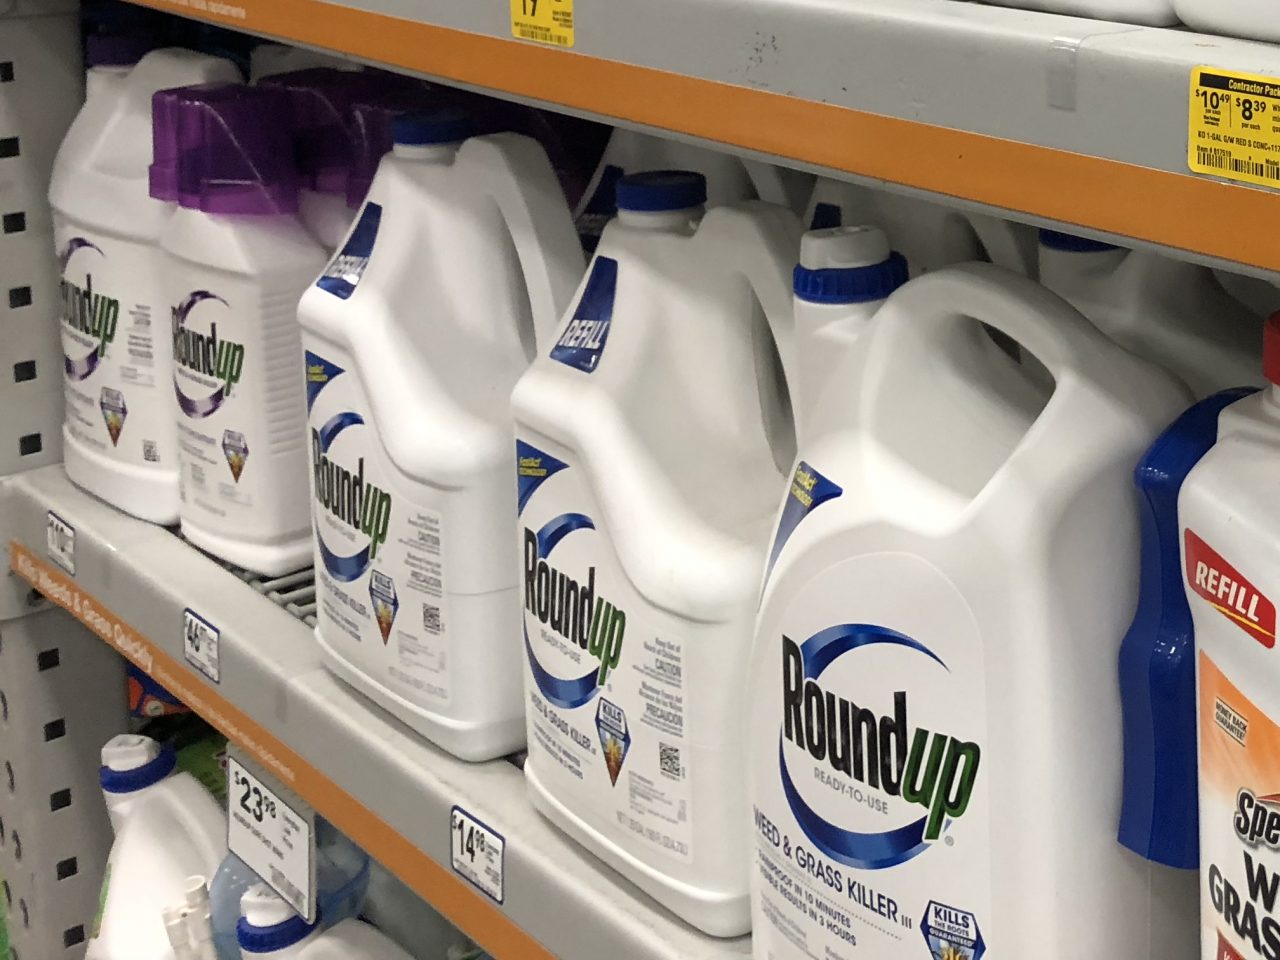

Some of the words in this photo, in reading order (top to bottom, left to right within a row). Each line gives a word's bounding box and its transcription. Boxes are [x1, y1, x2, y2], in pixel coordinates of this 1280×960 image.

[1228, 79, 1264, 95] Contractor
[1207, 132, 1222, 143] 1-GAL
[1235, 136, 1247, 147] RED
[1241, 122, 1249, 131] per
[1249, 123, 1261, 131] each
[558, 319, 610, 350] REFILL
[524, 527, 626, 686] Roundup
[1195, 560, 1260, 623] REFILL
[602, 700, 622, 724] KILLS
[1215, 700, 1232, 721] MONEY
[1232, 715, 1248, 732] BACK
[782, 634, 981, 843] Roundup
[813, 766, 889, 816] READY-TO-USE
[753, 803, 781, 848] WEED
[783, 835, 793, 860] &
[795, 846, 843, 894] GRASS
[847, 877, 898, 924] KILLER
[901, 913, 913, 930] III
[794, 883, 803, 897] IN
[804, 889, 814, 904] 10
[815, 895, 852, 929] MINUTES
[934, 905, 970, 929] KILLS
[934, 920, 946, 930] THE
[947, 924, 970, 937] ROOTS
